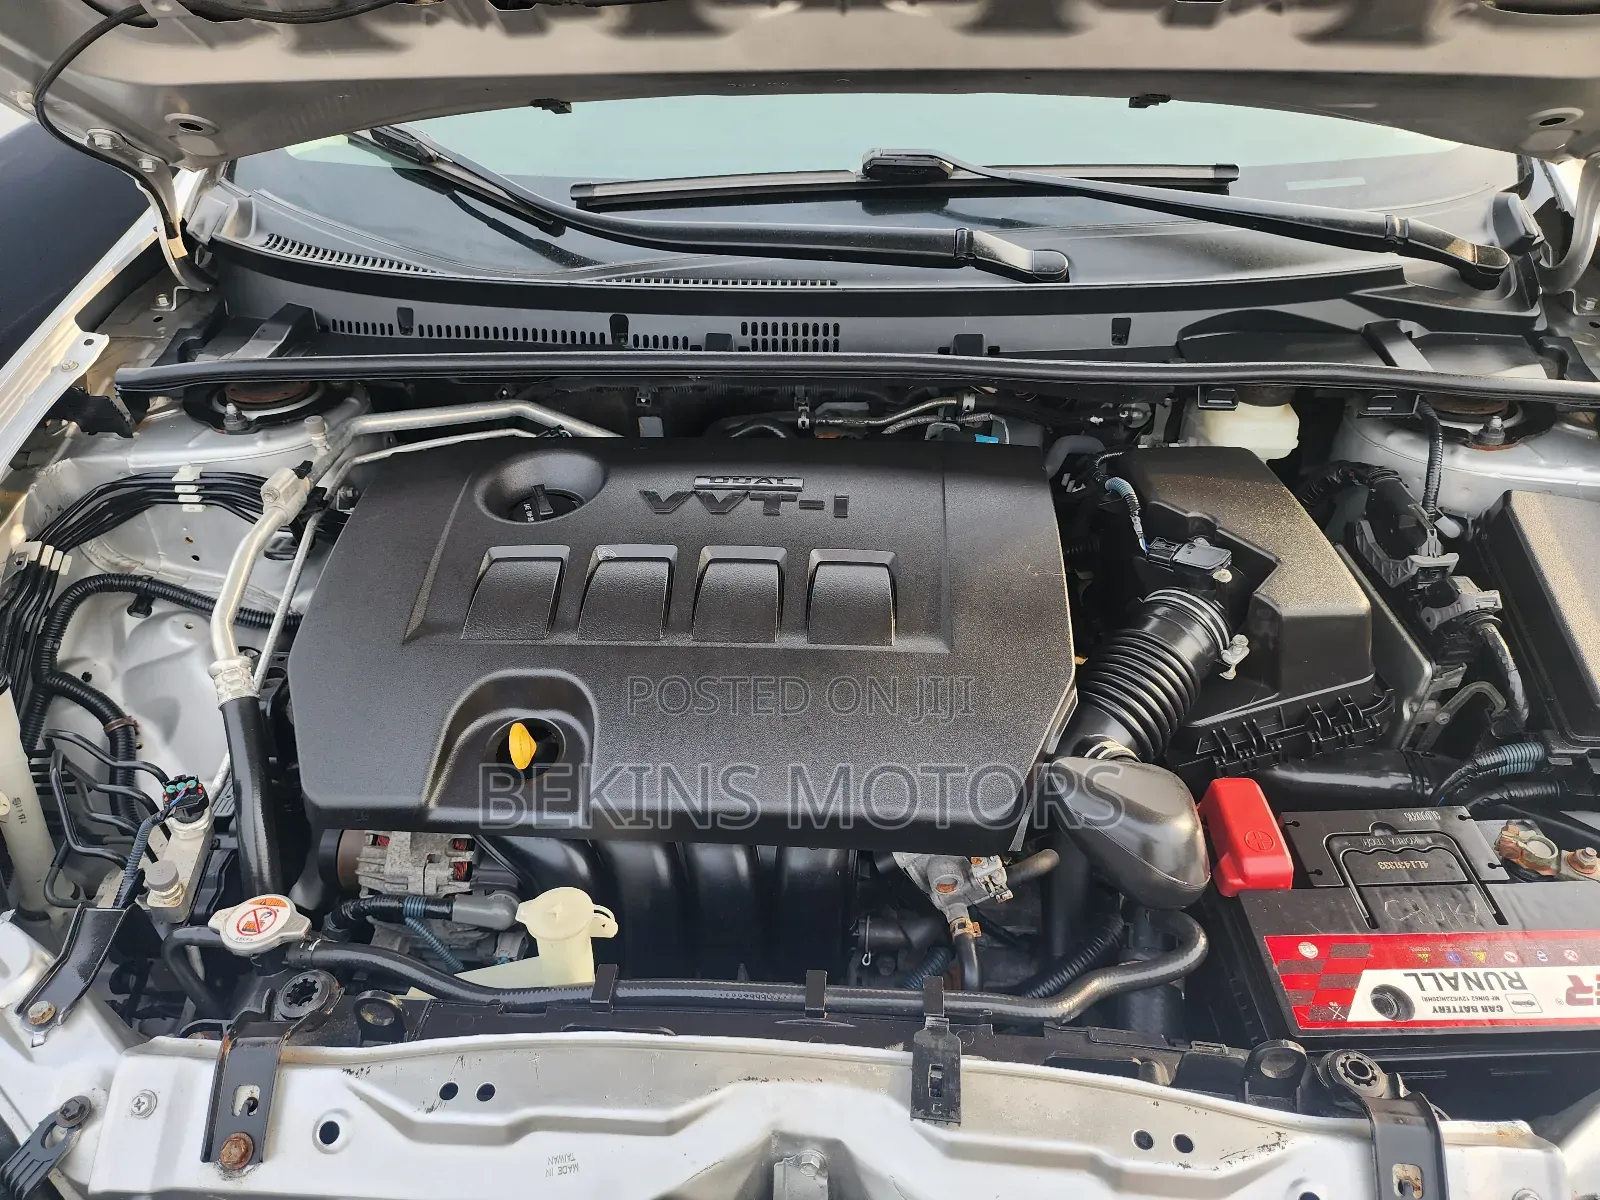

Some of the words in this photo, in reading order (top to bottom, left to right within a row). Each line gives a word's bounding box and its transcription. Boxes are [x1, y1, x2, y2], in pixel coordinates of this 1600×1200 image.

[1402, 971, 1529, 992] RUNALL
[1431, 1005, 1479, 1014] BATTERY
[1480, 1004, 1504, 1013] CAR
[547, 1152, 577, 1166] TAIWAN
[545, 1167, 554, 1178] IN
[557, 1162, 579, 1176] MADE
